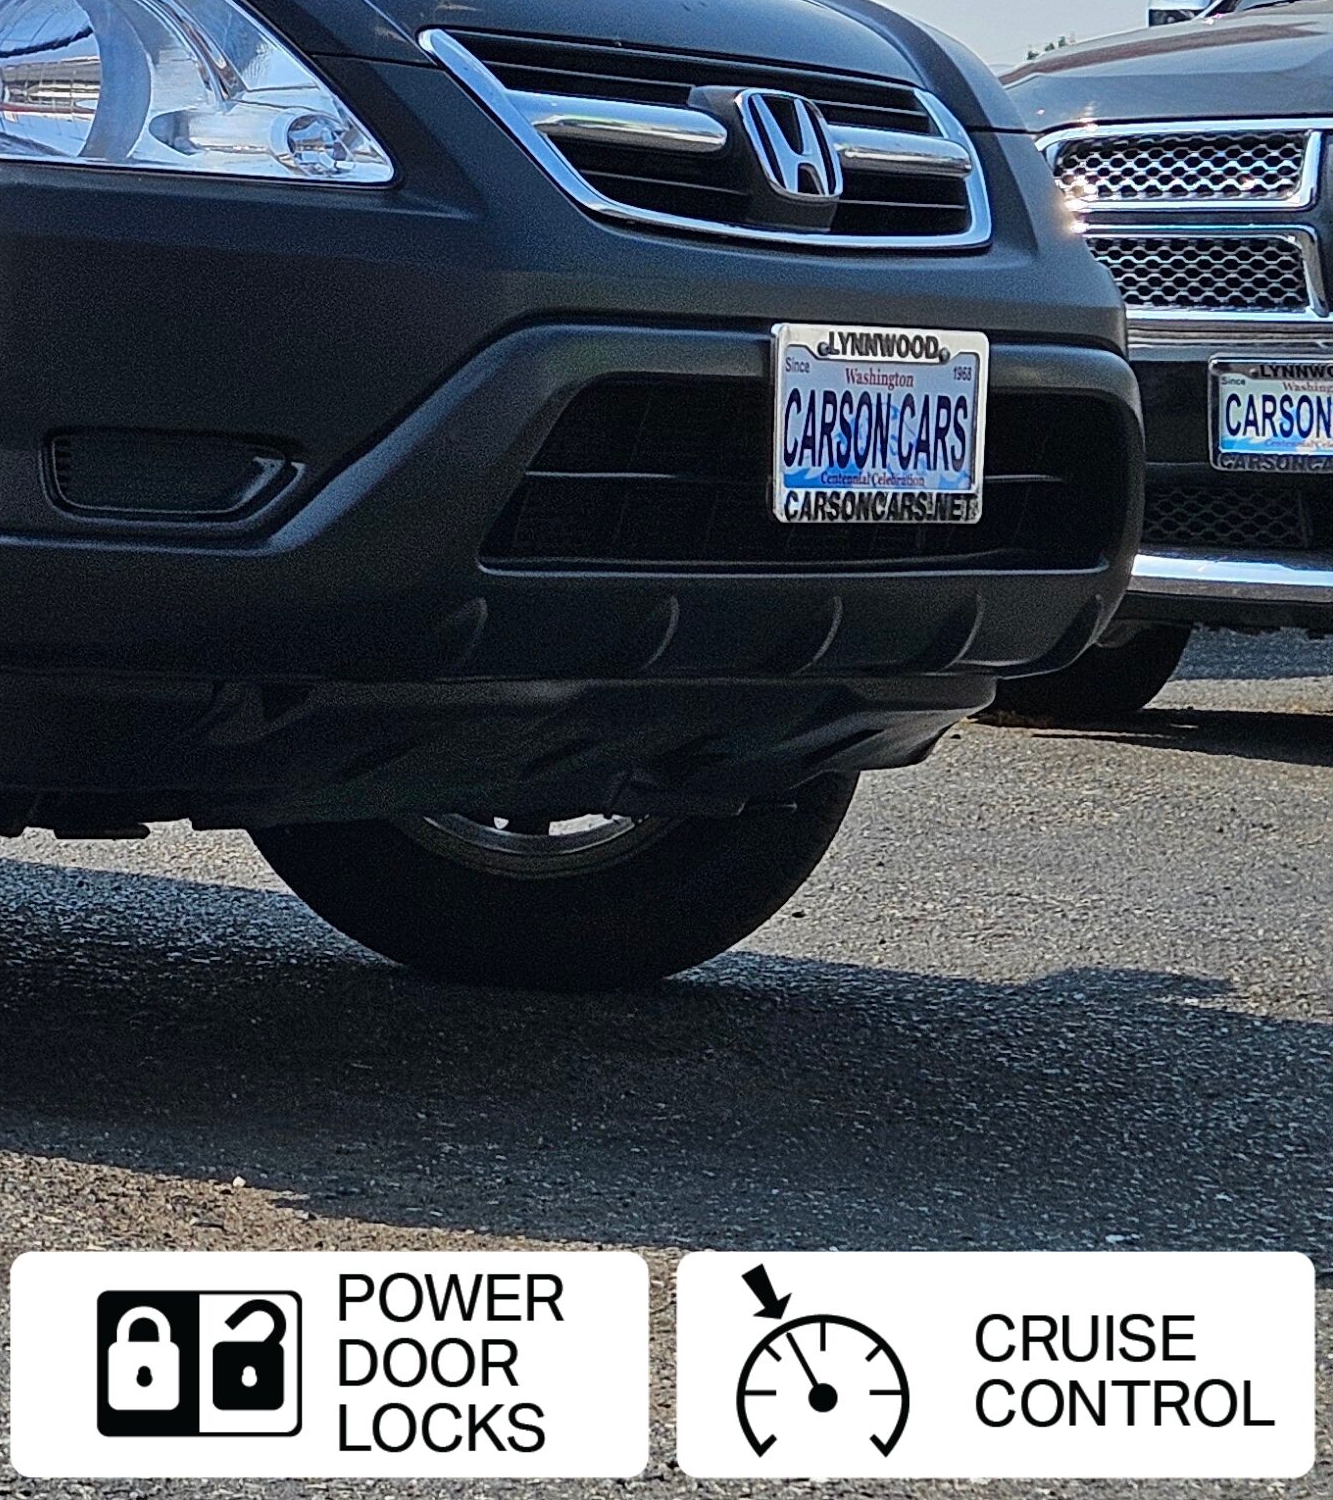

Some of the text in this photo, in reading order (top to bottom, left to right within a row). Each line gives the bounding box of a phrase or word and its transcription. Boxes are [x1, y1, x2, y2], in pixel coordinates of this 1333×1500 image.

[828, 331, 940, 359] LYNNWOOD
[785, 357, 810, 374] Since
[845, 367, 915, 390] Washington
[783, 387, 969, 473] CARSON CARS
[1225, 393, 1332, 439] CARSON
